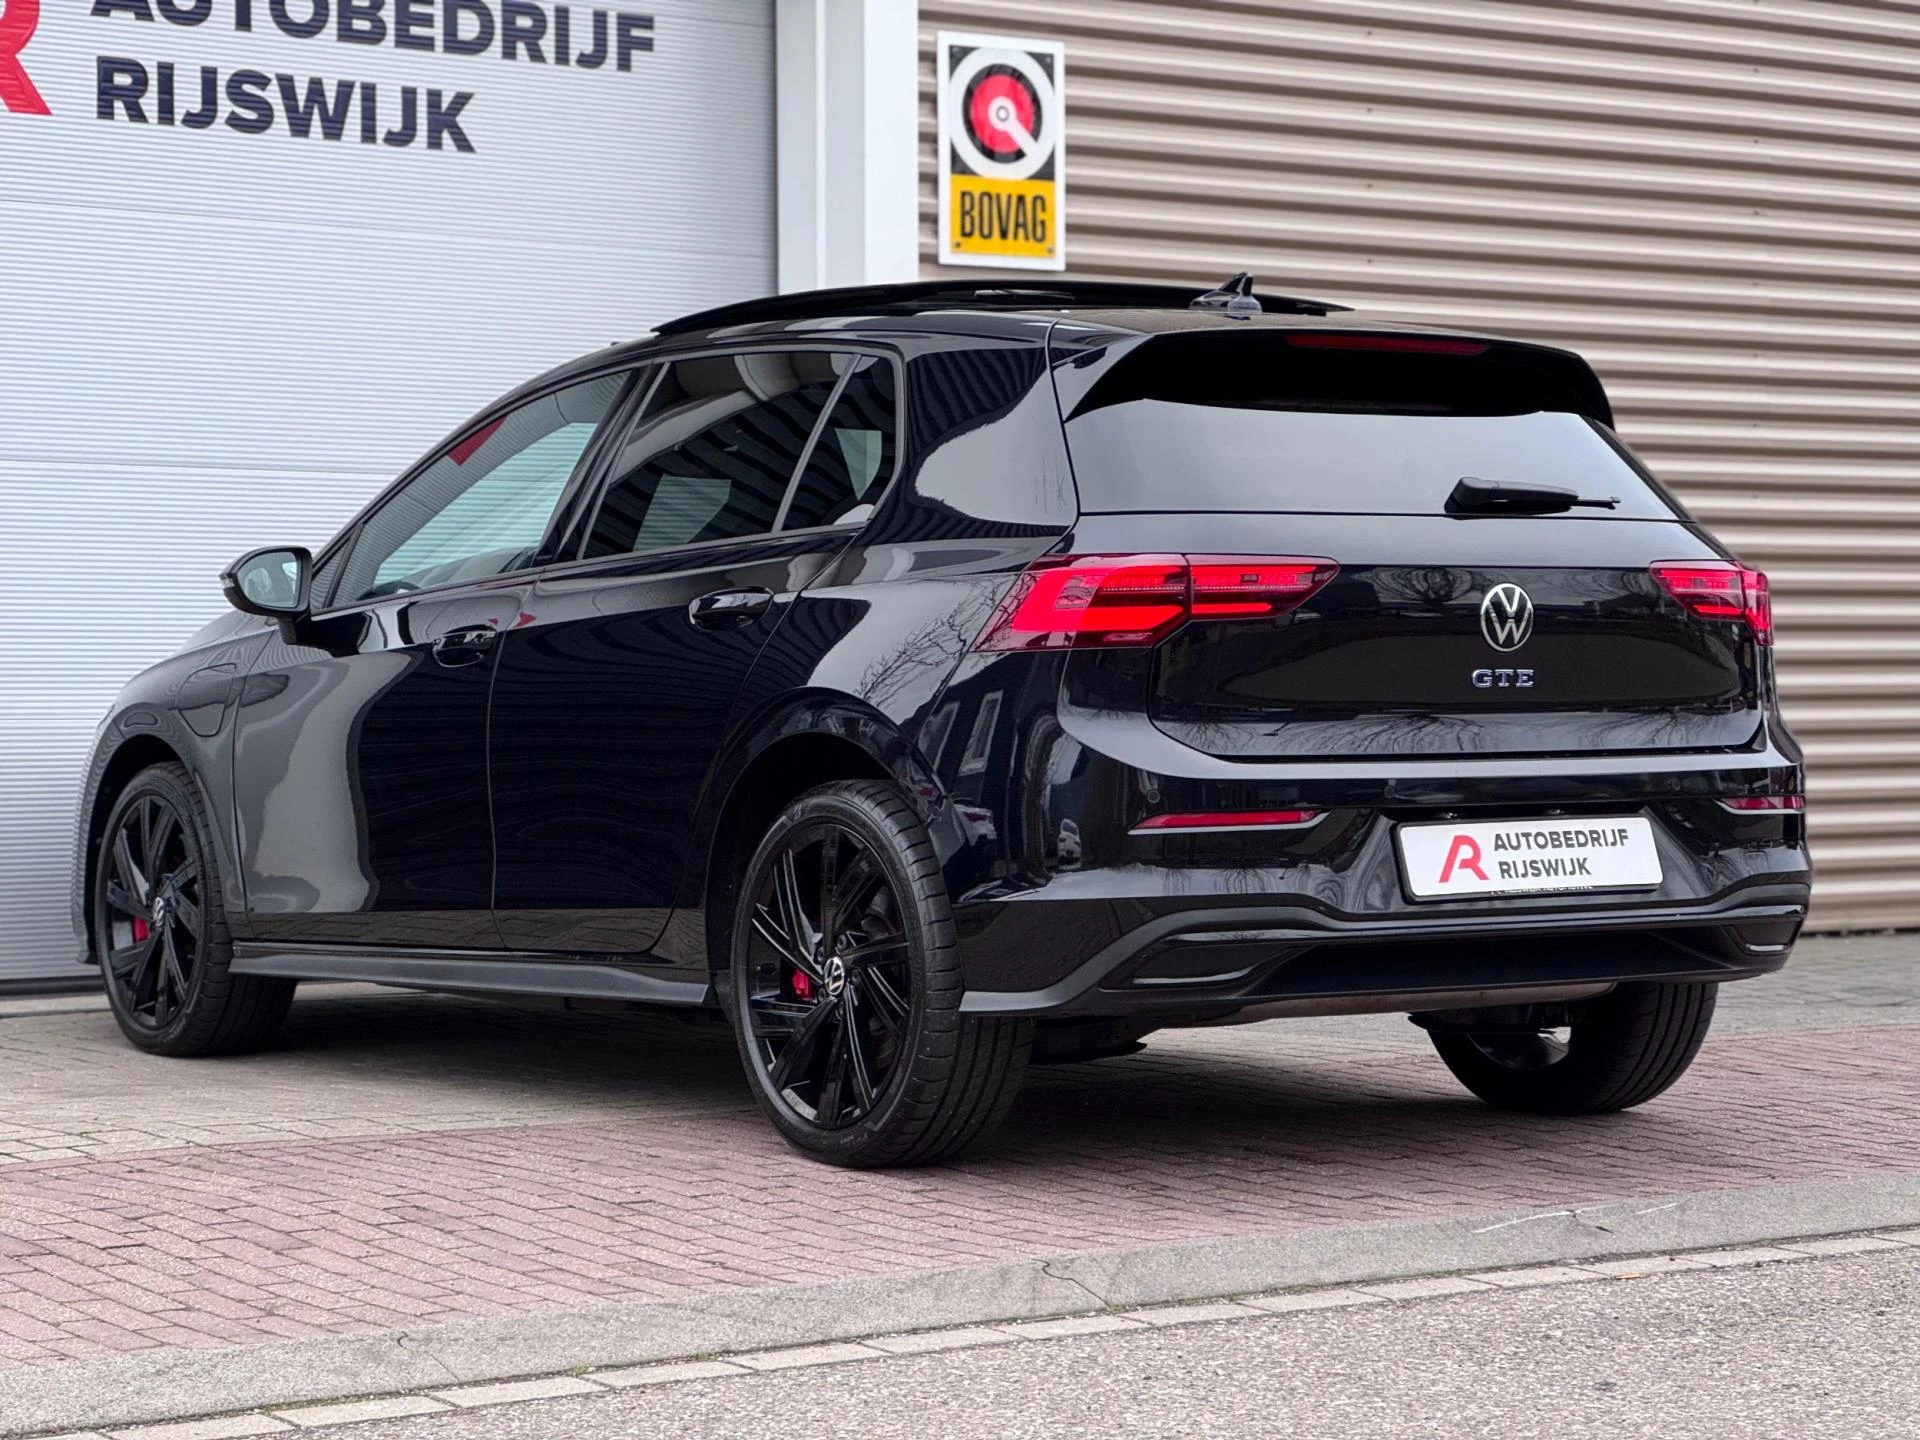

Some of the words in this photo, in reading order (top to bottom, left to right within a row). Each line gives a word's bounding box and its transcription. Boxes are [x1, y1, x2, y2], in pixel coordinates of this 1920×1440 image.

[96, 55, 476, 153] RIJSWIJK
[960, 190, 1047, 243] BOVAG
[1472, 669, 1535, 688] GTE
[1494, 828, 1629, 851] AUTOBEDRIJF
[1498, 857, 1592, 879] RIJSWIJK
